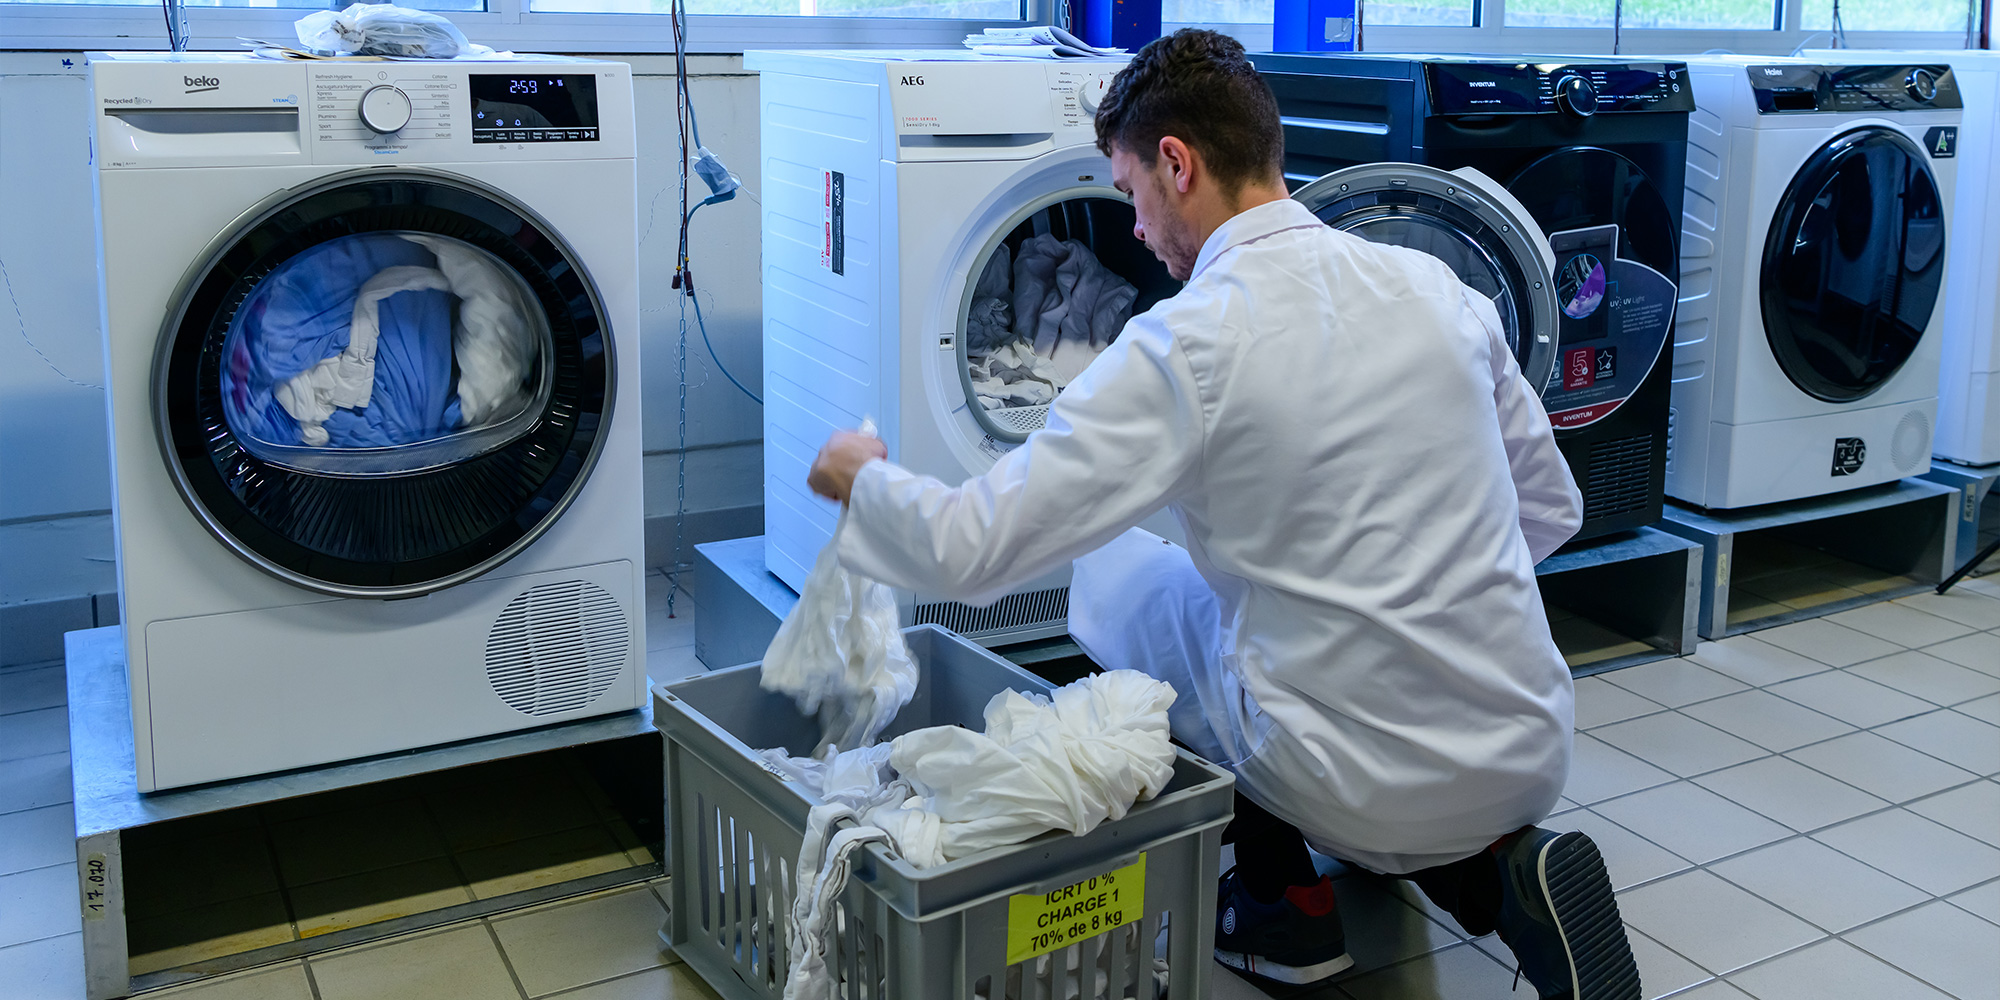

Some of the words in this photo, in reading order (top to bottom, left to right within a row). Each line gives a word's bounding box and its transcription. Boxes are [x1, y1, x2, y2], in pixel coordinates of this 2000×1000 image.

[1764, 68, 1783, 76] Haier
[184, 76, 220, 87] beko
[510, 80, 537, 93] 2:59
[900, 76, 925, 86] AEG
[1572, 350, 1588, 377] 5
[1563, 411, 1593, 422] INVENTUM
[1045, 881, 1084, 906] ICRT
[1088, 877, 1097, 891] 0
[1102, 872, 1115, 886] %
[1037, 892, 1107, 928] CHARGE
[1112, 888, 1119, 902] 1
[1031, 929, 1064, 952] 70%
[1068, 922, 1087, 939] de
[1092, 915, 1100, 930] 8
[1105, 910, 1123, 926] kg
